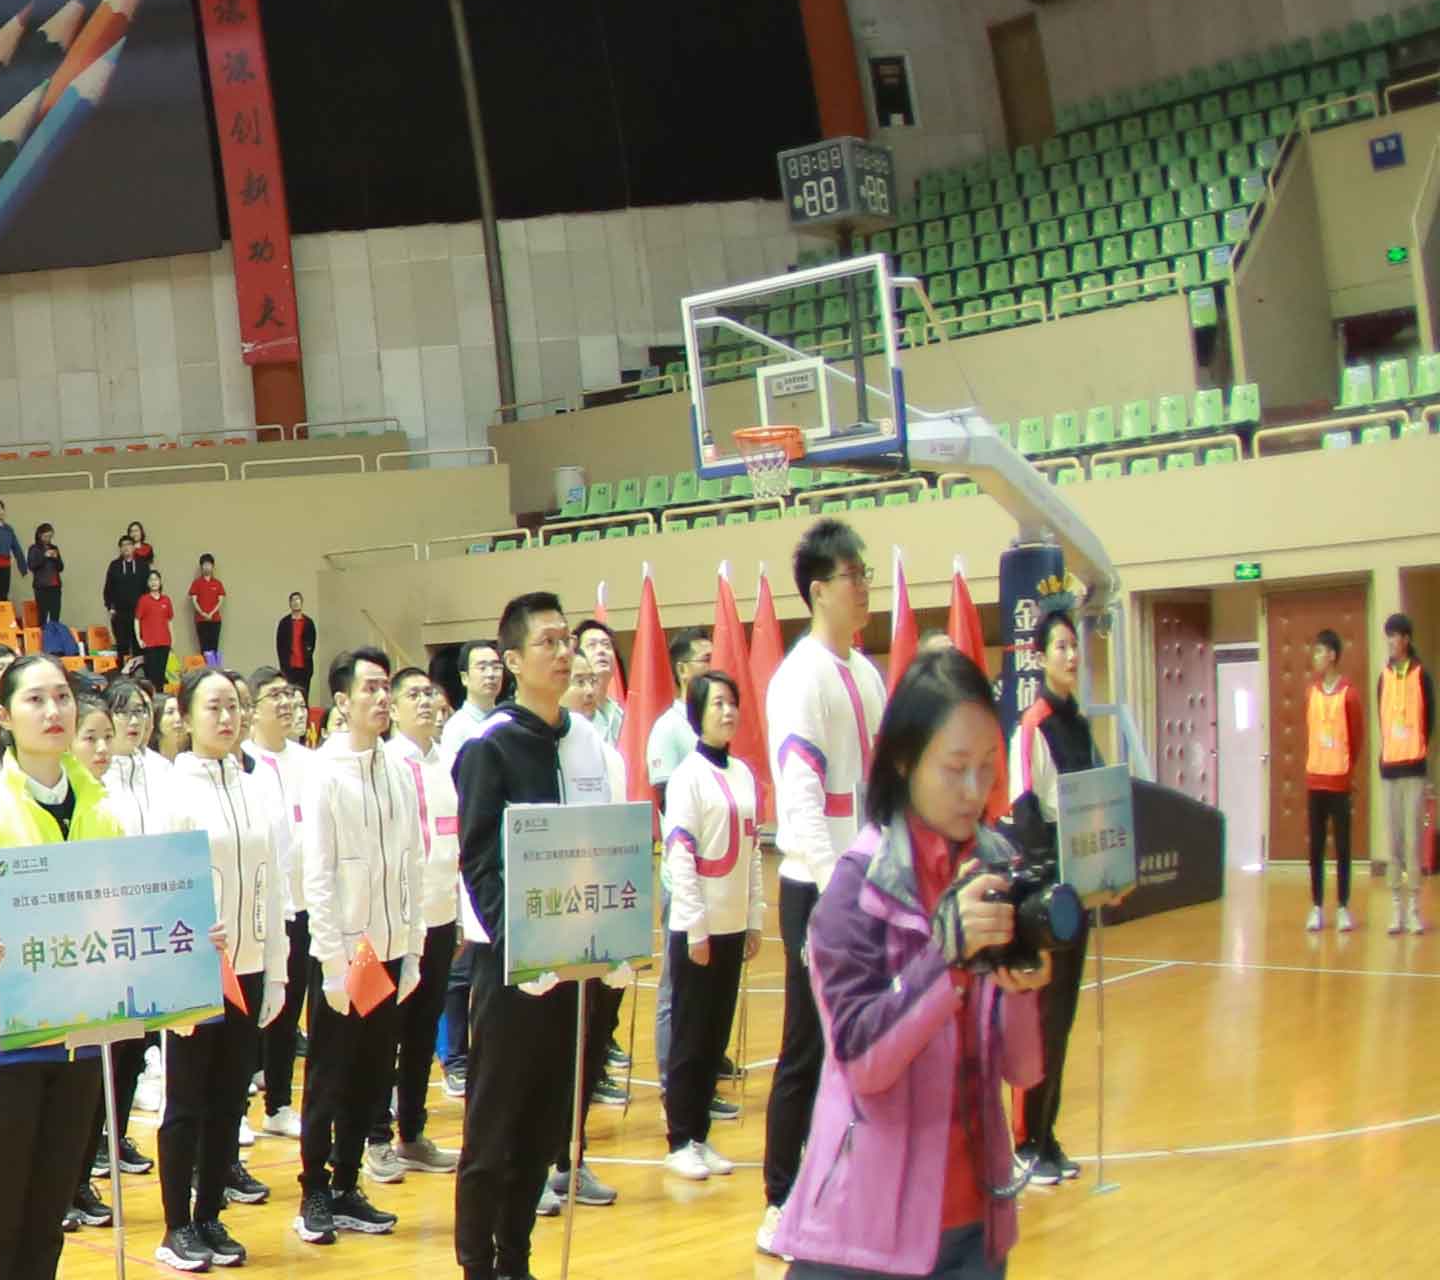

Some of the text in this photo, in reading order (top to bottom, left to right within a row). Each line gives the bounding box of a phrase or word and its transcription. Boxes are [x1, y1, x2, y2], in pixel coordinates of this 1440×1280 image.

[526, 880, 638, 919] 商业公司工会
[22, 920, 194, 972] 申达公司工会
